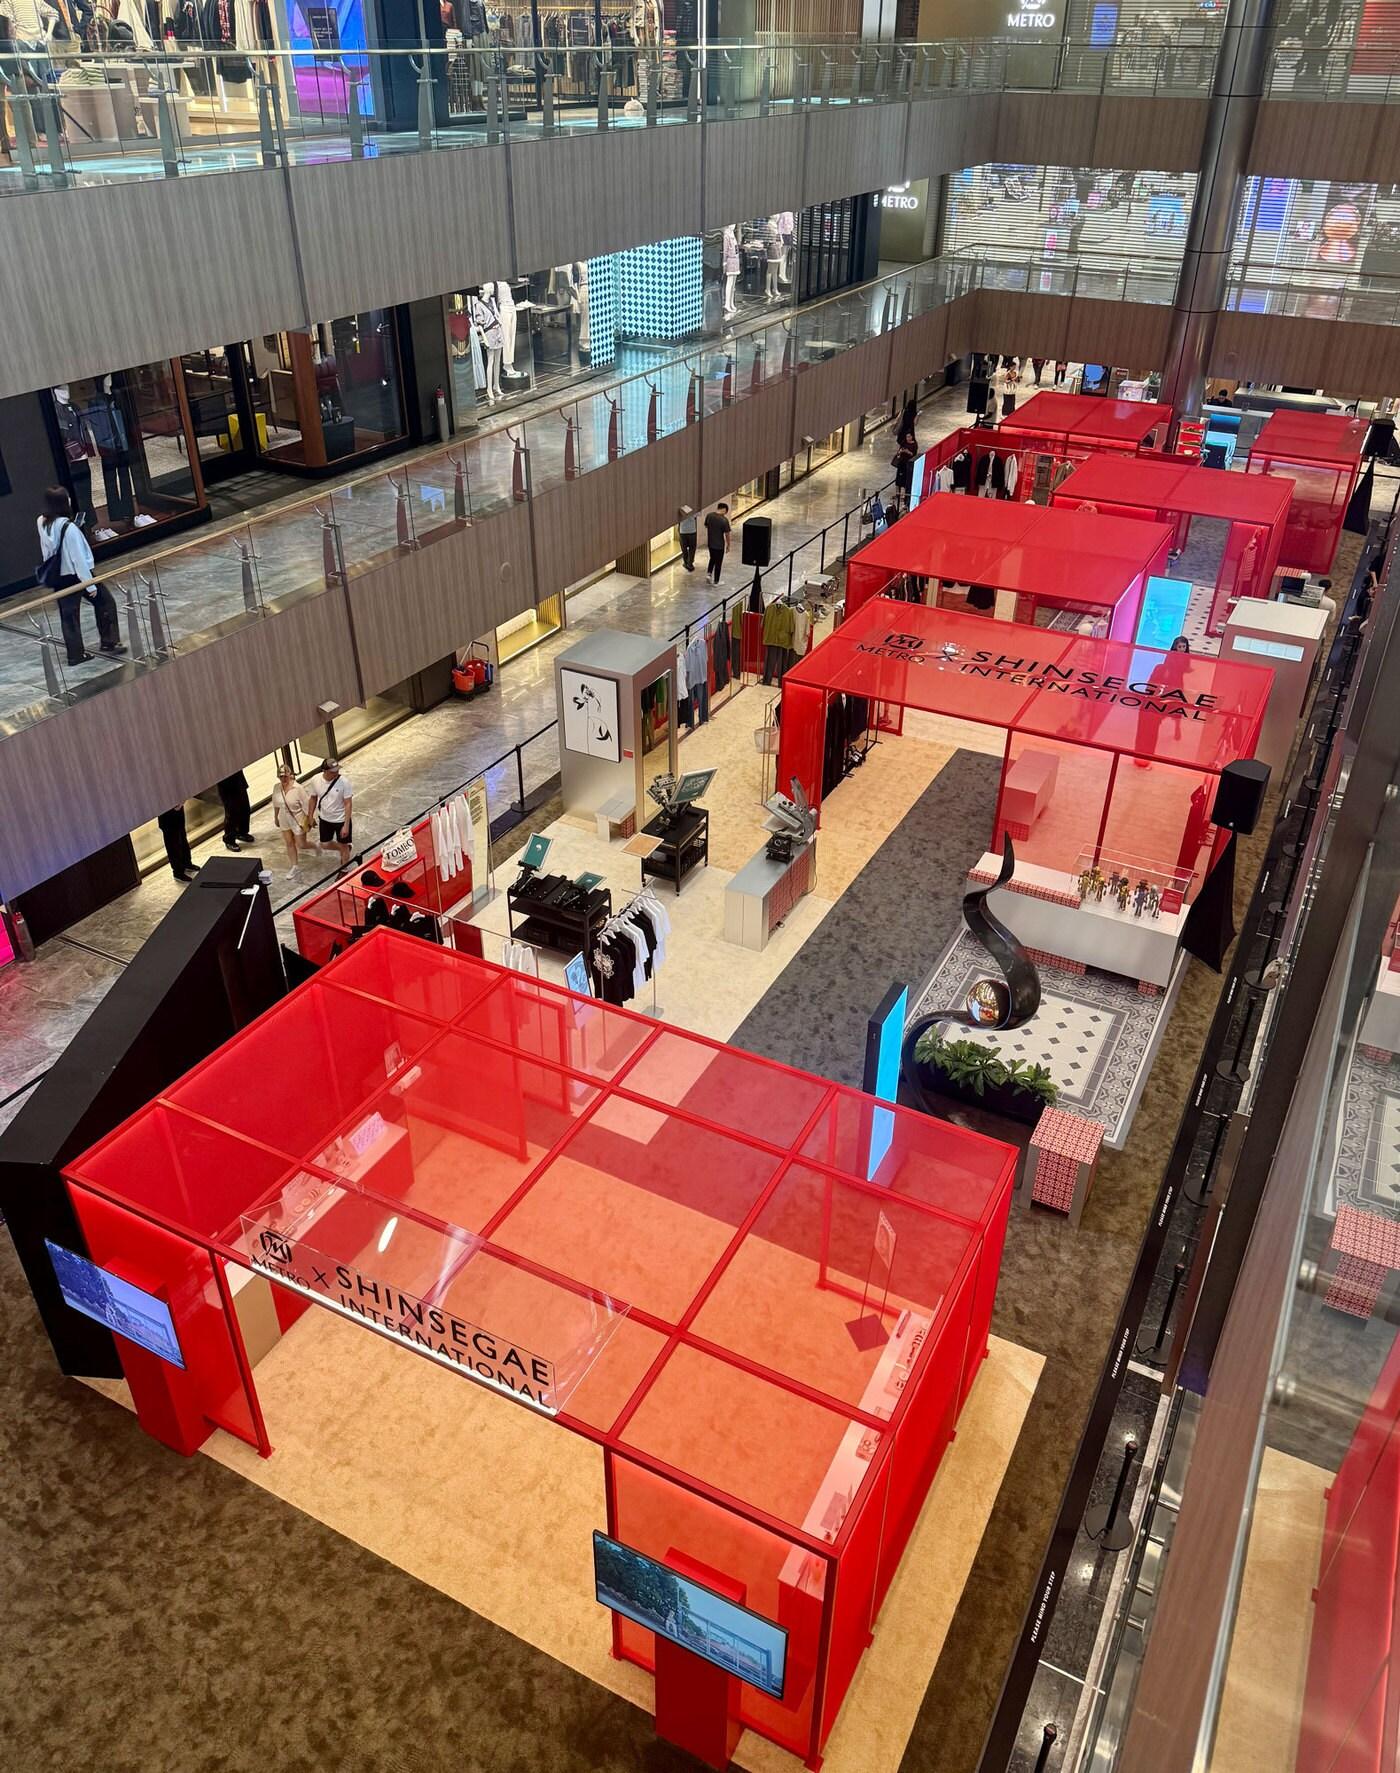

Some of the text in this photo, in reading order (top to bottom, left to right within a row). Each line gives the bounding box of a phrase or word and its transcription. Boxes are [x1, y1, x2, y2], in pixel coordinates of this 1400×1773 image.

[1007, 13, 1056, 28] METRO
[857, 644, 925, 663] METRO
[971, 650, 1218, 709] SHINSEGAE
[960, 663, 1207, 722] INTERNATIONAL
[250, 1254, 311, 1290] METRO
[335, 1265, 550, 1386] SHINSEGAE
[340, 1294, 552, 1410] INTERNATIONAL
[1031, 1571, 1056, 1643] PLEASE MIND YOUR STEP
